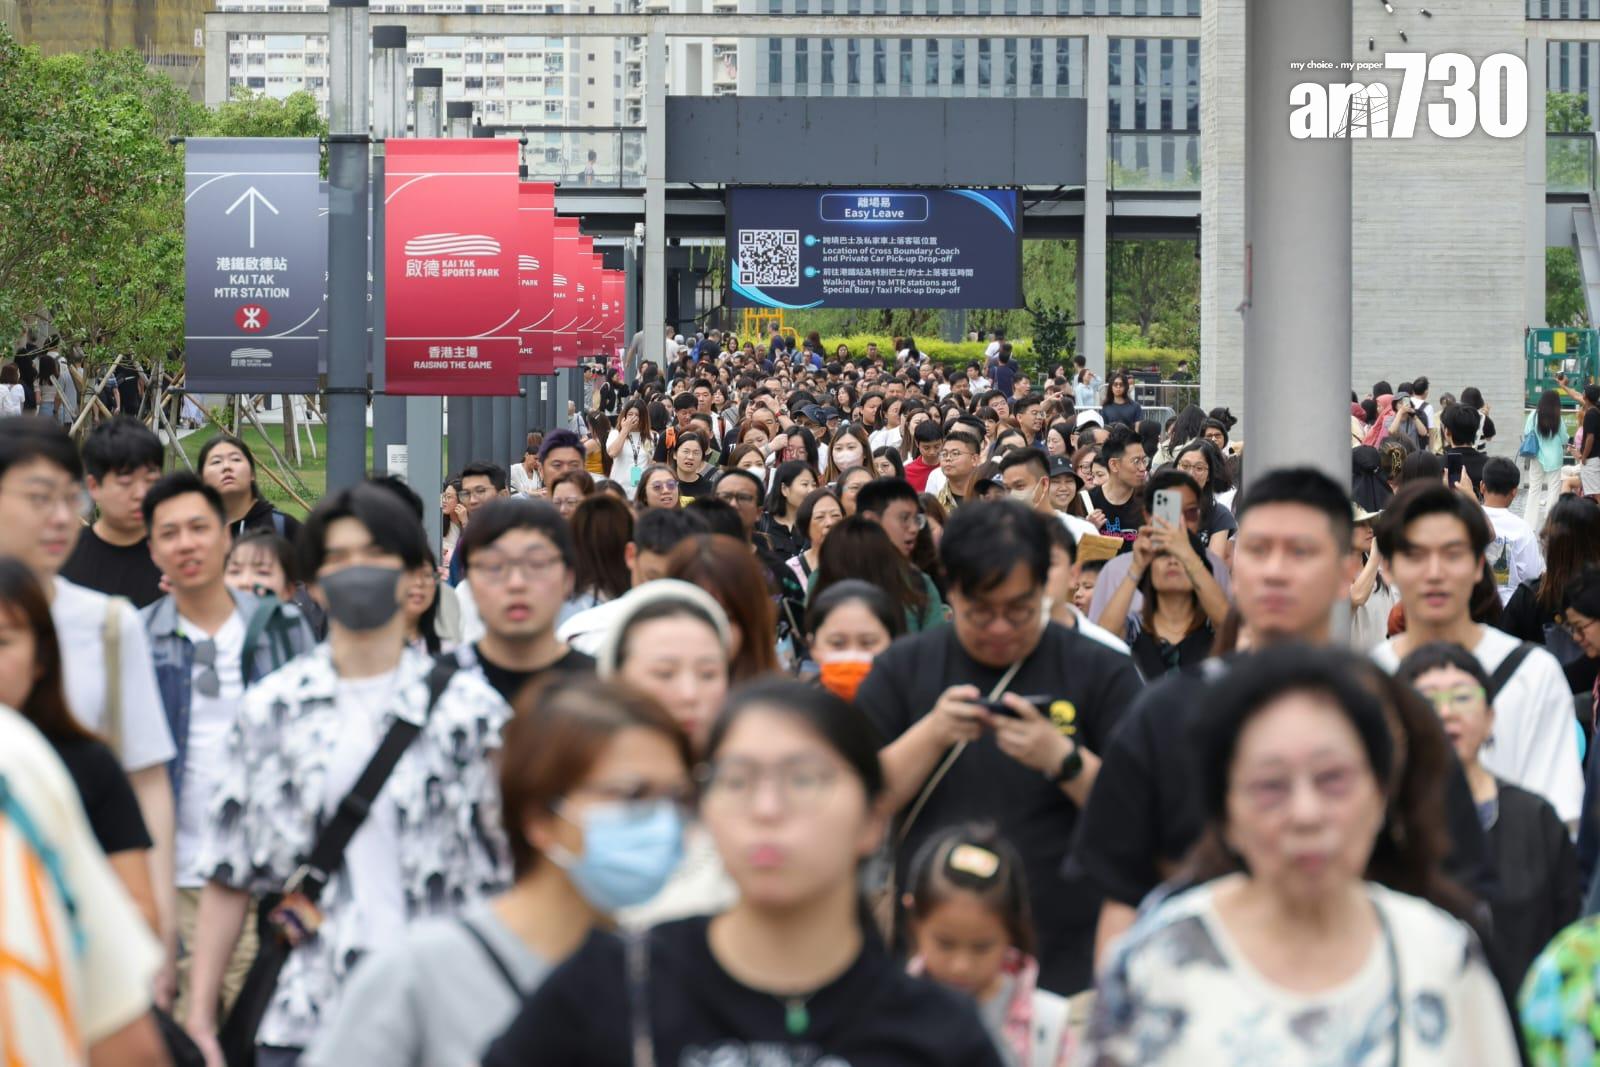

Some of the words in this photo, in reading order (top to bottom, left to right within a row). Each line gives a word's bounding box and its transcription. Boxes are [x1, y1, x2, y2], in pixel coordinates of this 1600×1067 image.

[844, 208, 870, 220] Easy
[872, 208, 905, 218] Leave
[822, 247, 858, 255] Location
[859, 246, 868, 255] of
[869, 247, 892, 255] Cross
[893, 247, 933, 256] Boundary
[934, 247, 960, 255] Coach
[441, 259, 457, 268] KAI
[458, 259, 475, 268] TAK
[822, 255, 838, 263] and
[840, 255, 869, 263] Private
[870, 255, 885, 263] Car
[886, 255, 917, 264] Pick-up
[918, 255, 952, 264] Drop-off
[441, 268, 475, 277] SPORTS
[476, 268, 500, 277] PARK
[229, 274, 249, 285] KAI
[250, 274, 275, 285] TAK
[521, 279, 539, 287] PARK
[822, 278, 856, 287] Walking
[857, 278, 876, 286] time
[887, 279, 906, 287] MTR
[907, 278, 940, 286] stations
[214, 287, 239, 298] MTR
[239, 287, 290, 298] STATION
[822, 286, 853, 295] Special
[875, 286, 893, 294] Taxi
[893, 286, 925, 295] Pick-up
[926, 286, 960, 295] Drop-off
[428, 345, 479, 358] 香港主場
[413, 361, 448, 369] RAISING
[449, 361, 467, 369] THE
[467, 361, 493, 369] GAME
